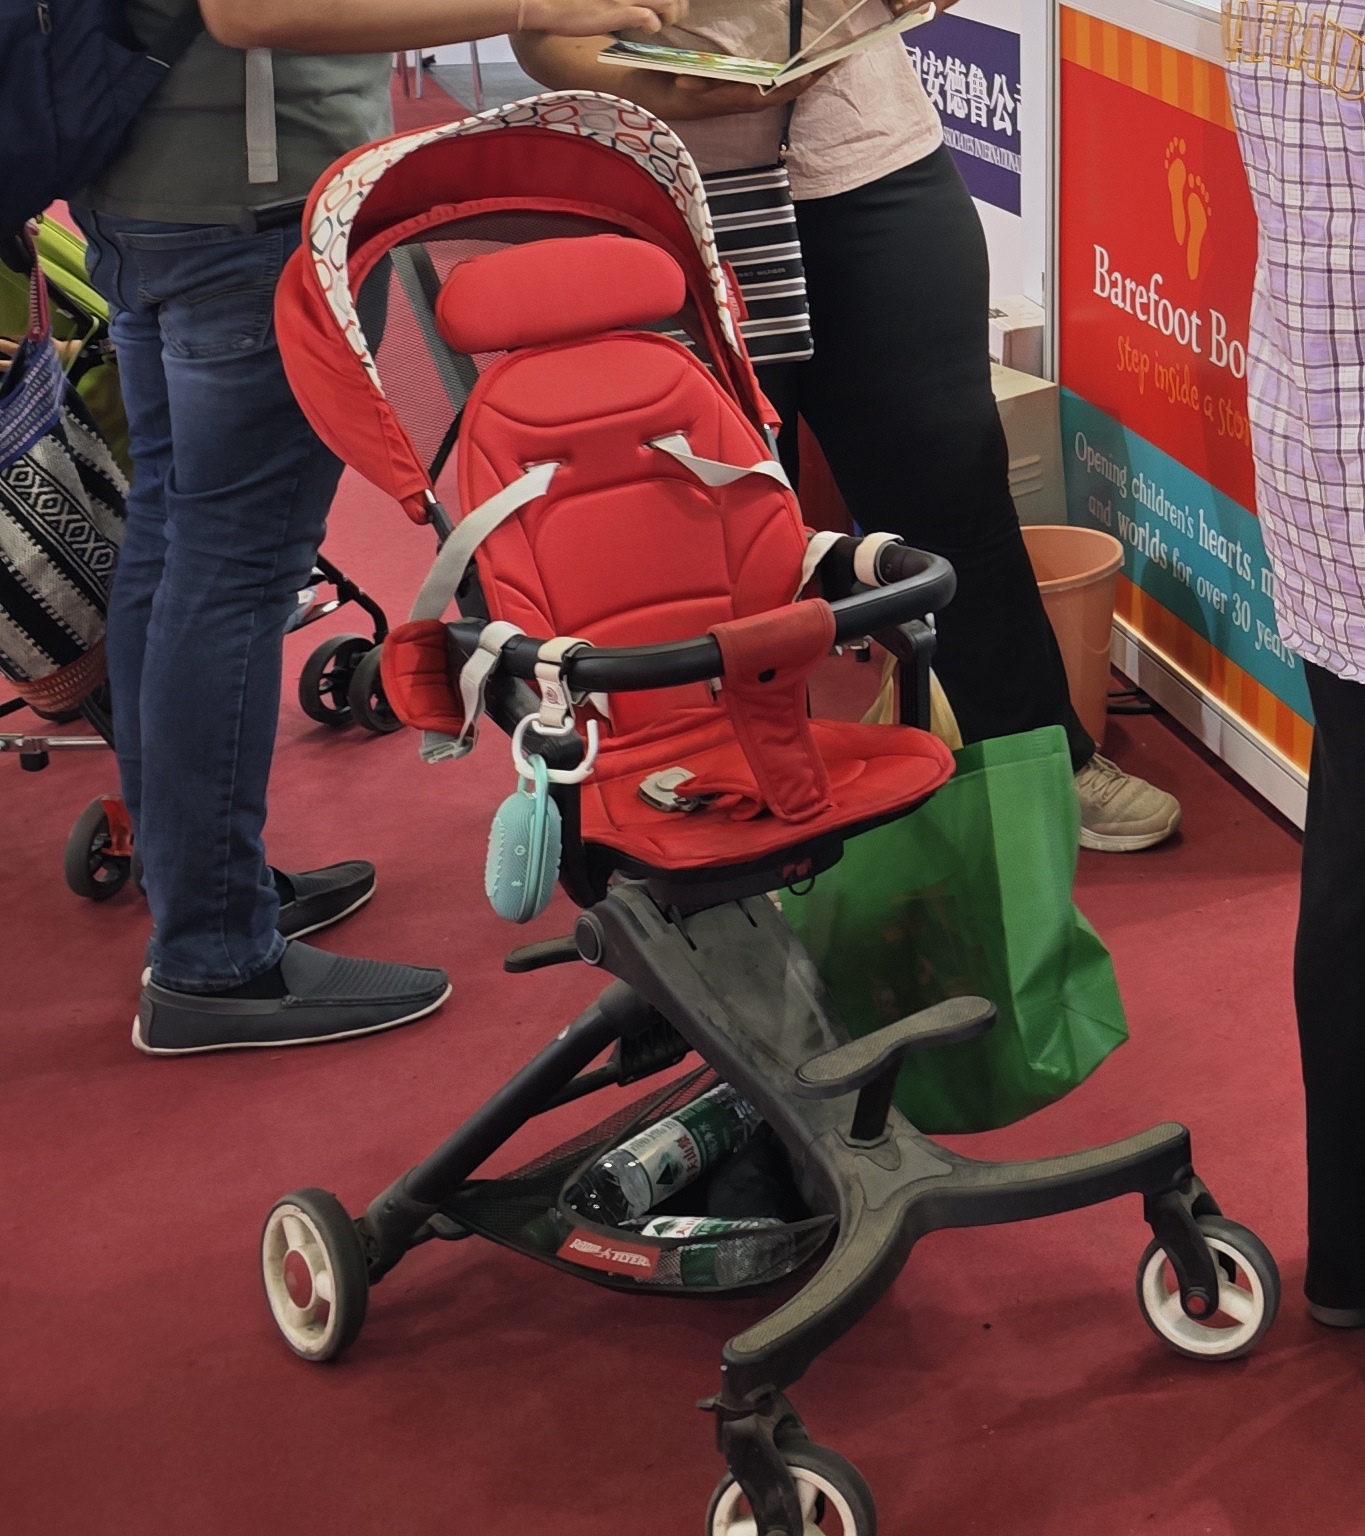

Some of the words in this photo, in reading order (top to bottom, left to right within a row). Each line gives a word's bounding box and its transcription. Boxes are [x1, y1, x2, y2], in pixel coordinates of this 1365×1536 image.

[1093, 243, 1202, 354] Barefoot
[1154, 350, 1199, 411] inside
[1203, 394, 1215, 422] a
[1075, 431, 1127, 498] Opening
[1131, 472, 1194, 539] children's
[1199, 508, 1256, 590] hearts,
[1089, 495, 1112, 528] and
[1117, 510, 1168, 571] worlds
[1172, 547, 1193, 588] for
[1196, 576, 1228, 615] over
[1232, 592, 1250, 633] 30
